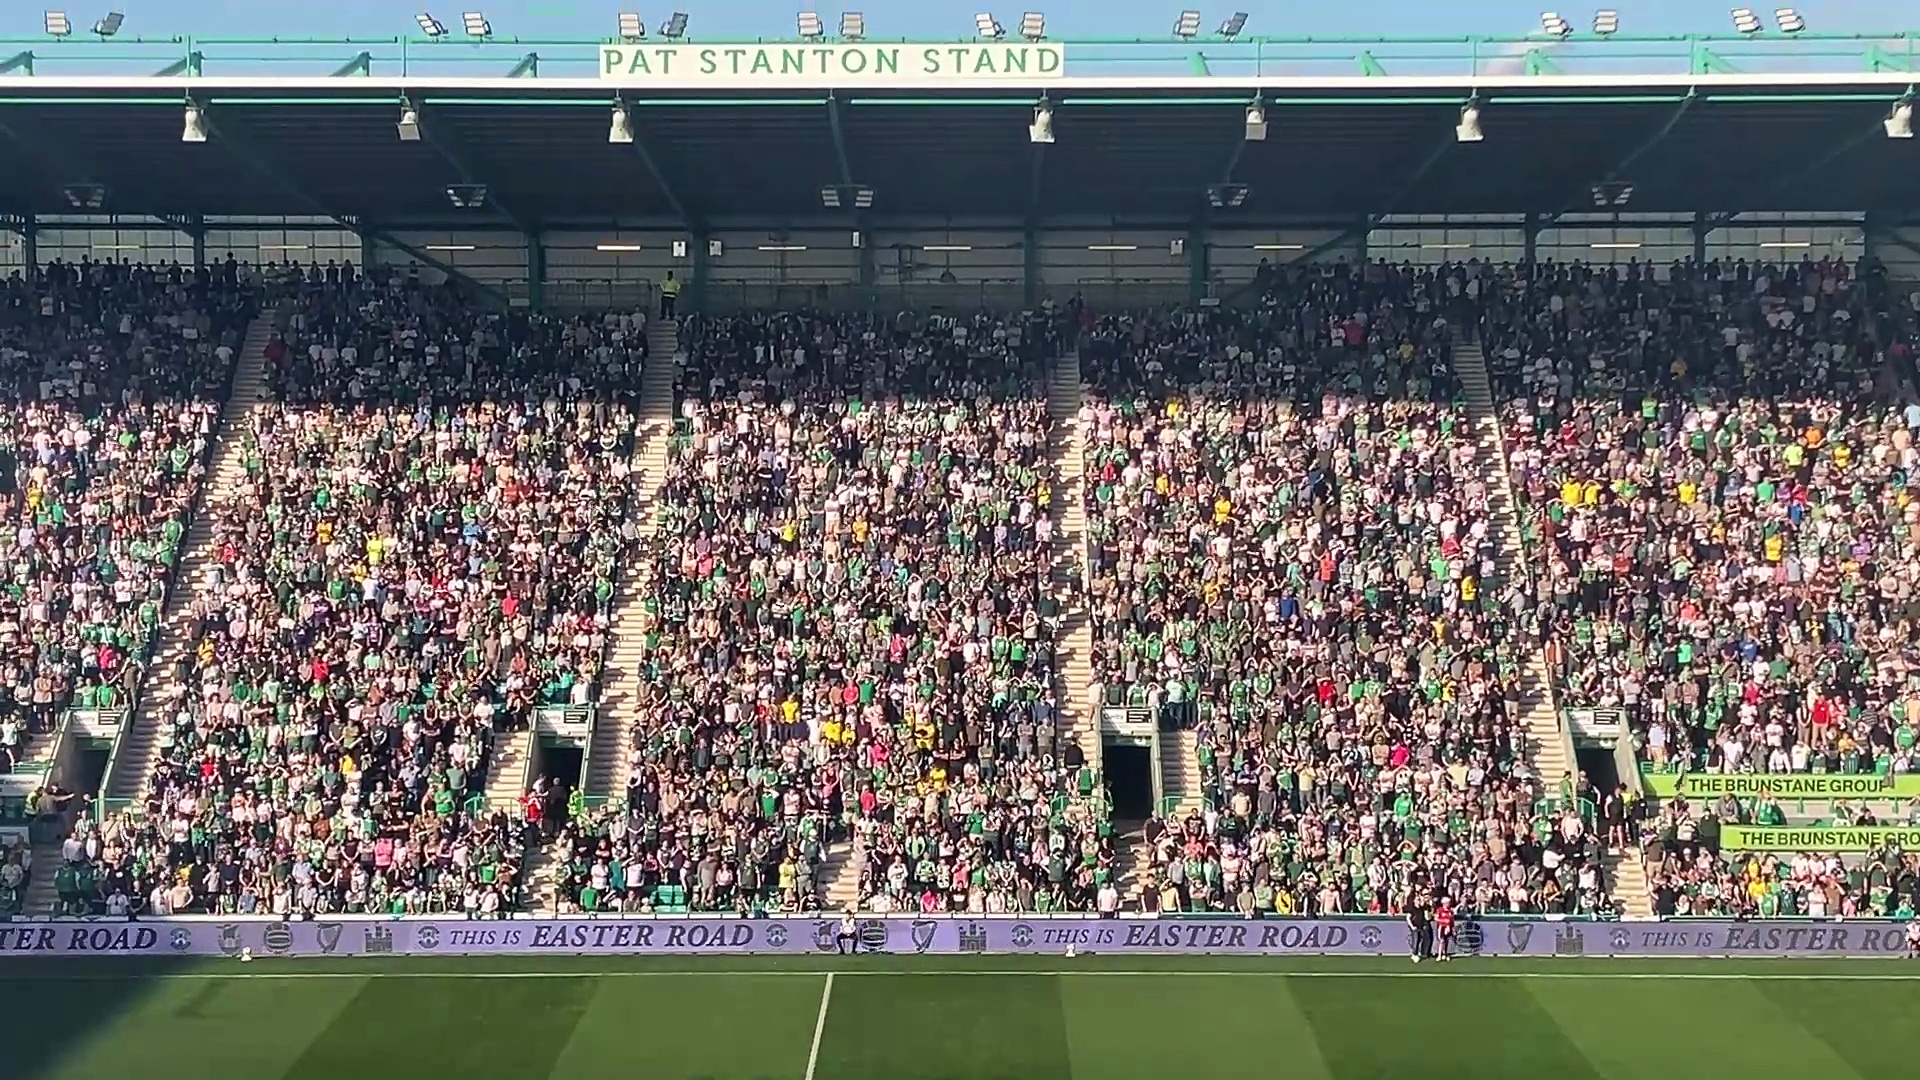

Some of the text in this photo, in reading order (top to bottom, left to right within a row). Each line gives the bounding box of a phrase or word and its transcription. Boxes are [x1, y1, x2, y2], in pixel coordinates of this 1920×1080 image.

[604, 48, 1060, 74] PAT STANTON STAND
[1688, 779, 1721, 792] THE
[1725, 779, 1827, 792] BRUNSTANE
[1739, 832, 1774, 845] THE
[1778, 832, 1881, 846] BRUNSTANE
[0, 927, 158, 950] TER ROAD
[450, 924, 754, 947] THIS IS EASTER ROAD
[1043, 924, 1348, 948] THIS IS EASTER ROAD
[1641, 927, 1908, 951] THIS IS EASTER RO
